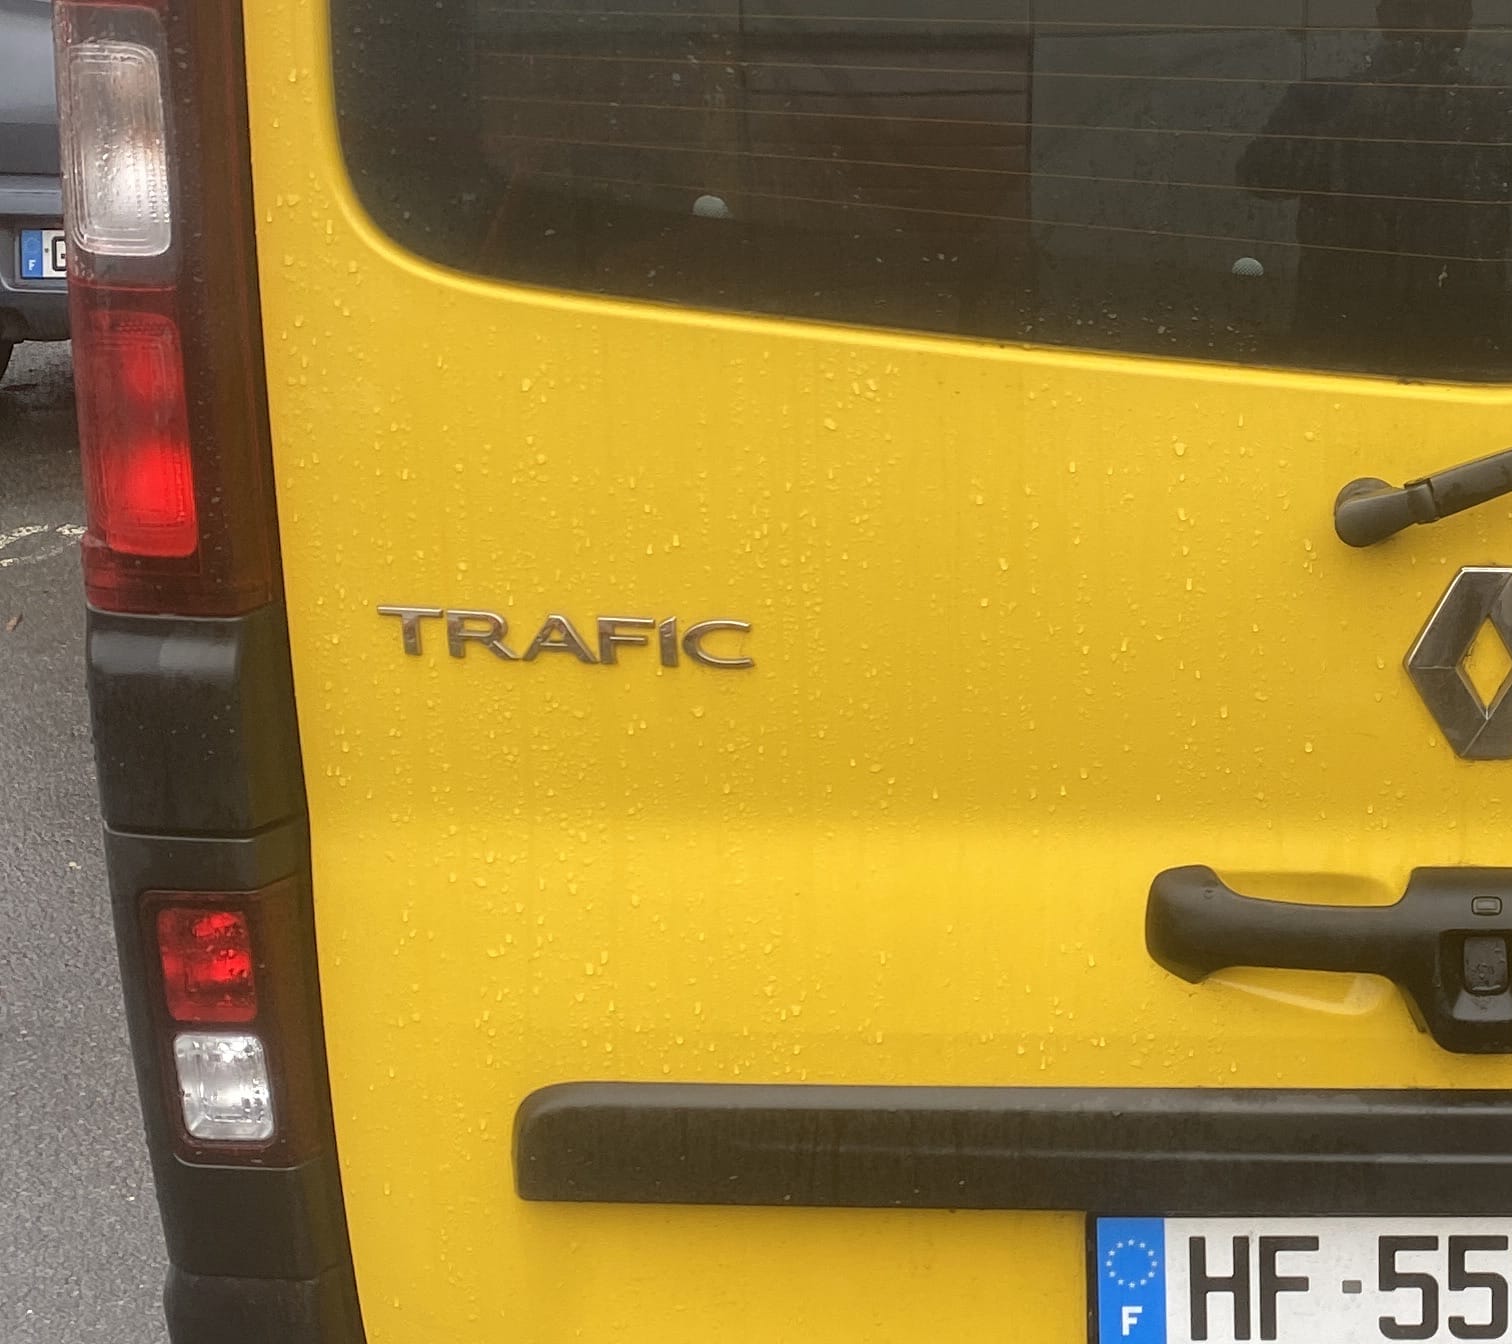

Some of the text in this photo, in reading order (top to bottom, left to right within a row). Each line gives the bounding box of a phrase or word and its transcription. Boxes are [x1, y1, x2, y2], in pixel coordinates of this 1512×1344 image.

[28, 259, 37, 271] F
[376, 604, 756, 669] TRAFIC
[1122, 1305, 1144, 1337] F
